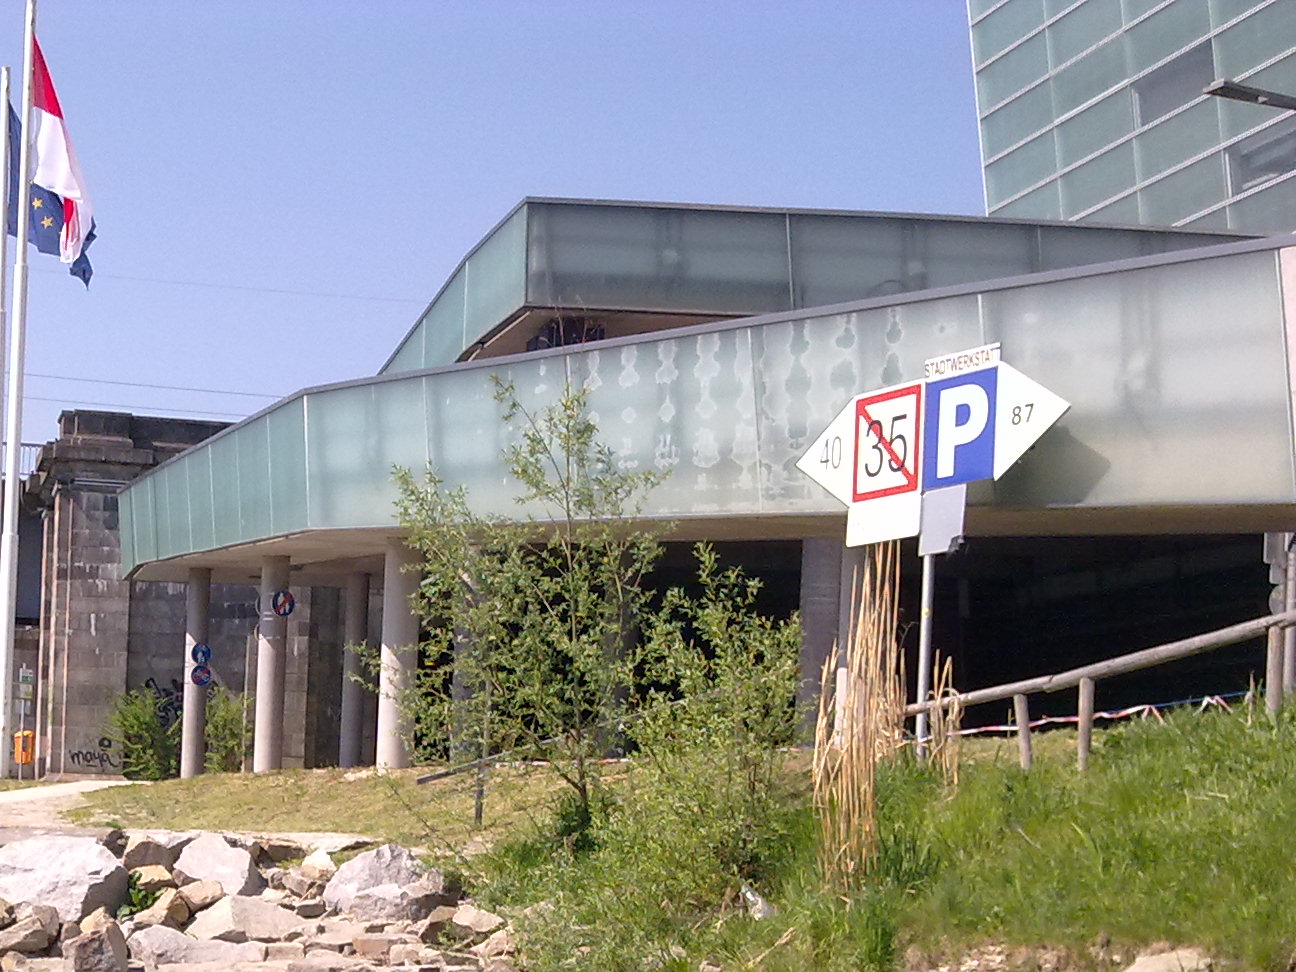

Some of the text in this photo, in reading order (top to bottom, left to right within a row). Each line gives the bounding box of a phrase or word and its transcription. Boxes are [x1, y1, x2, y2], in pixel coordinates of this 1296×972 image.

[936, 383, 989, 478] P
[1012, 403, 1034, 425] 87
[820, 436, 842, 469] 40
[865, 414, 907, 477] 35
